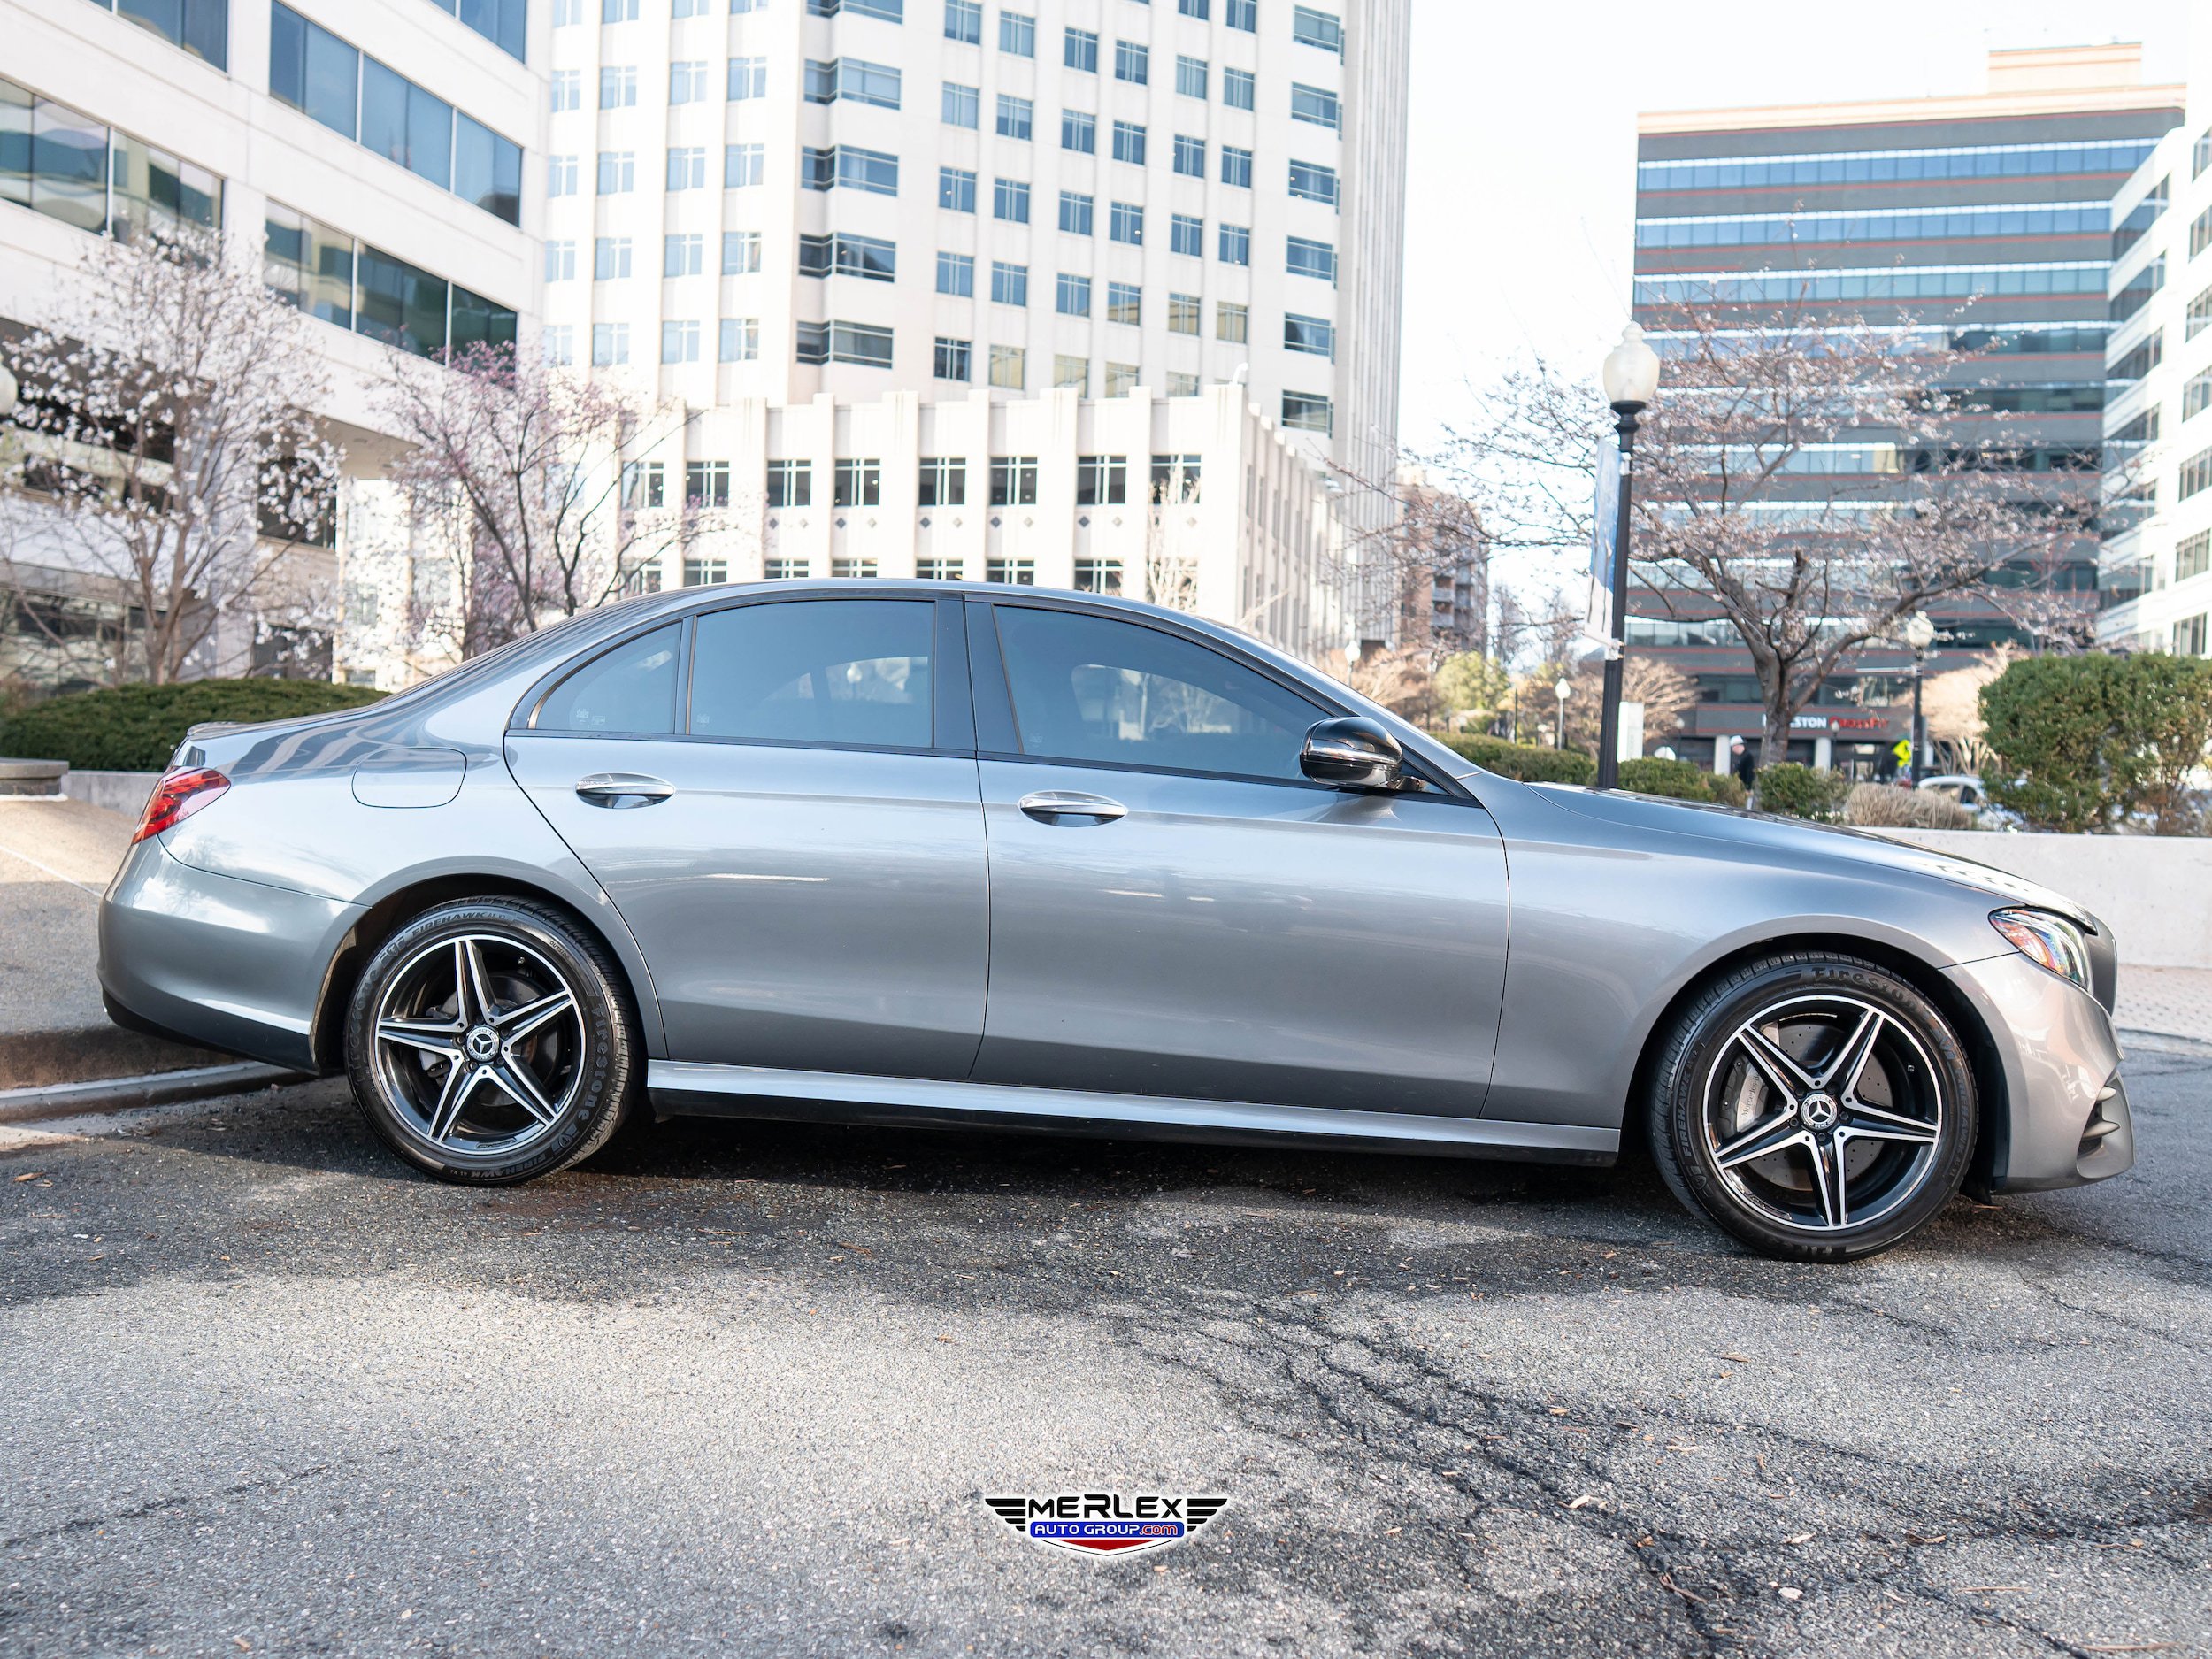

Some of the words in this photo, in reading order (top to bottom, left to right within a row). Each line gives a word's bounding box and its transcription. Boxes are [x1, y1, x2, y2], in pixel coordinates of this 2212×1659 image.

[1762, 713, 1827, 728] STON
[412, 912, 485, 937] FIREHAWK
[579, 1003, 608, 1121] Firestone
[1677, 1071, 1692, 1158] FIREHAWK
[471, 1152, 547, 1178] FIREHAWK
